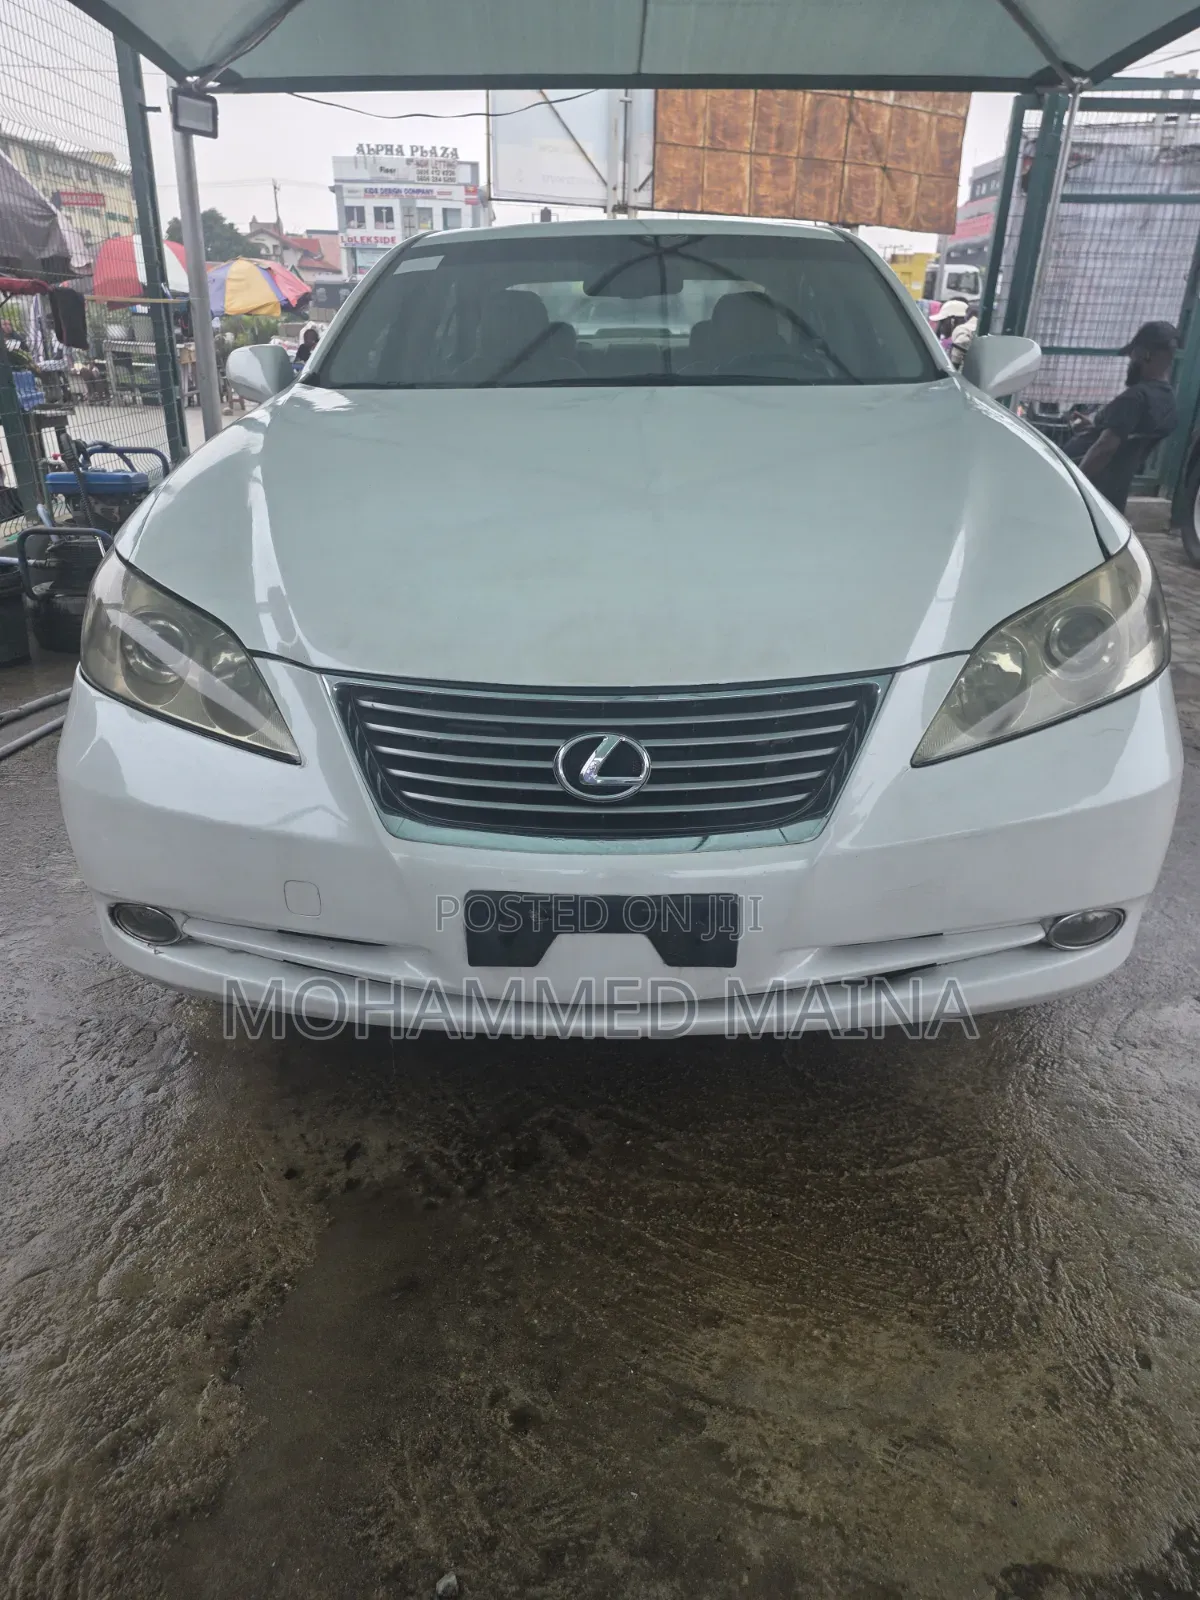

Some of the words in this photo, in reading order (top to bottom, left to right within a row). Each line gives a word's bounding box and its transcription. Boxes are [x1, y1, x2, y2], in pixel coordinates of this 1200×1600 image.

[355, 143, 405, 157] ALPHA
[409, 145, 460, 160] PLAZA
[380, 187, 402, 195] DESIGN
[403, 188, 434, 196] COMPANY
